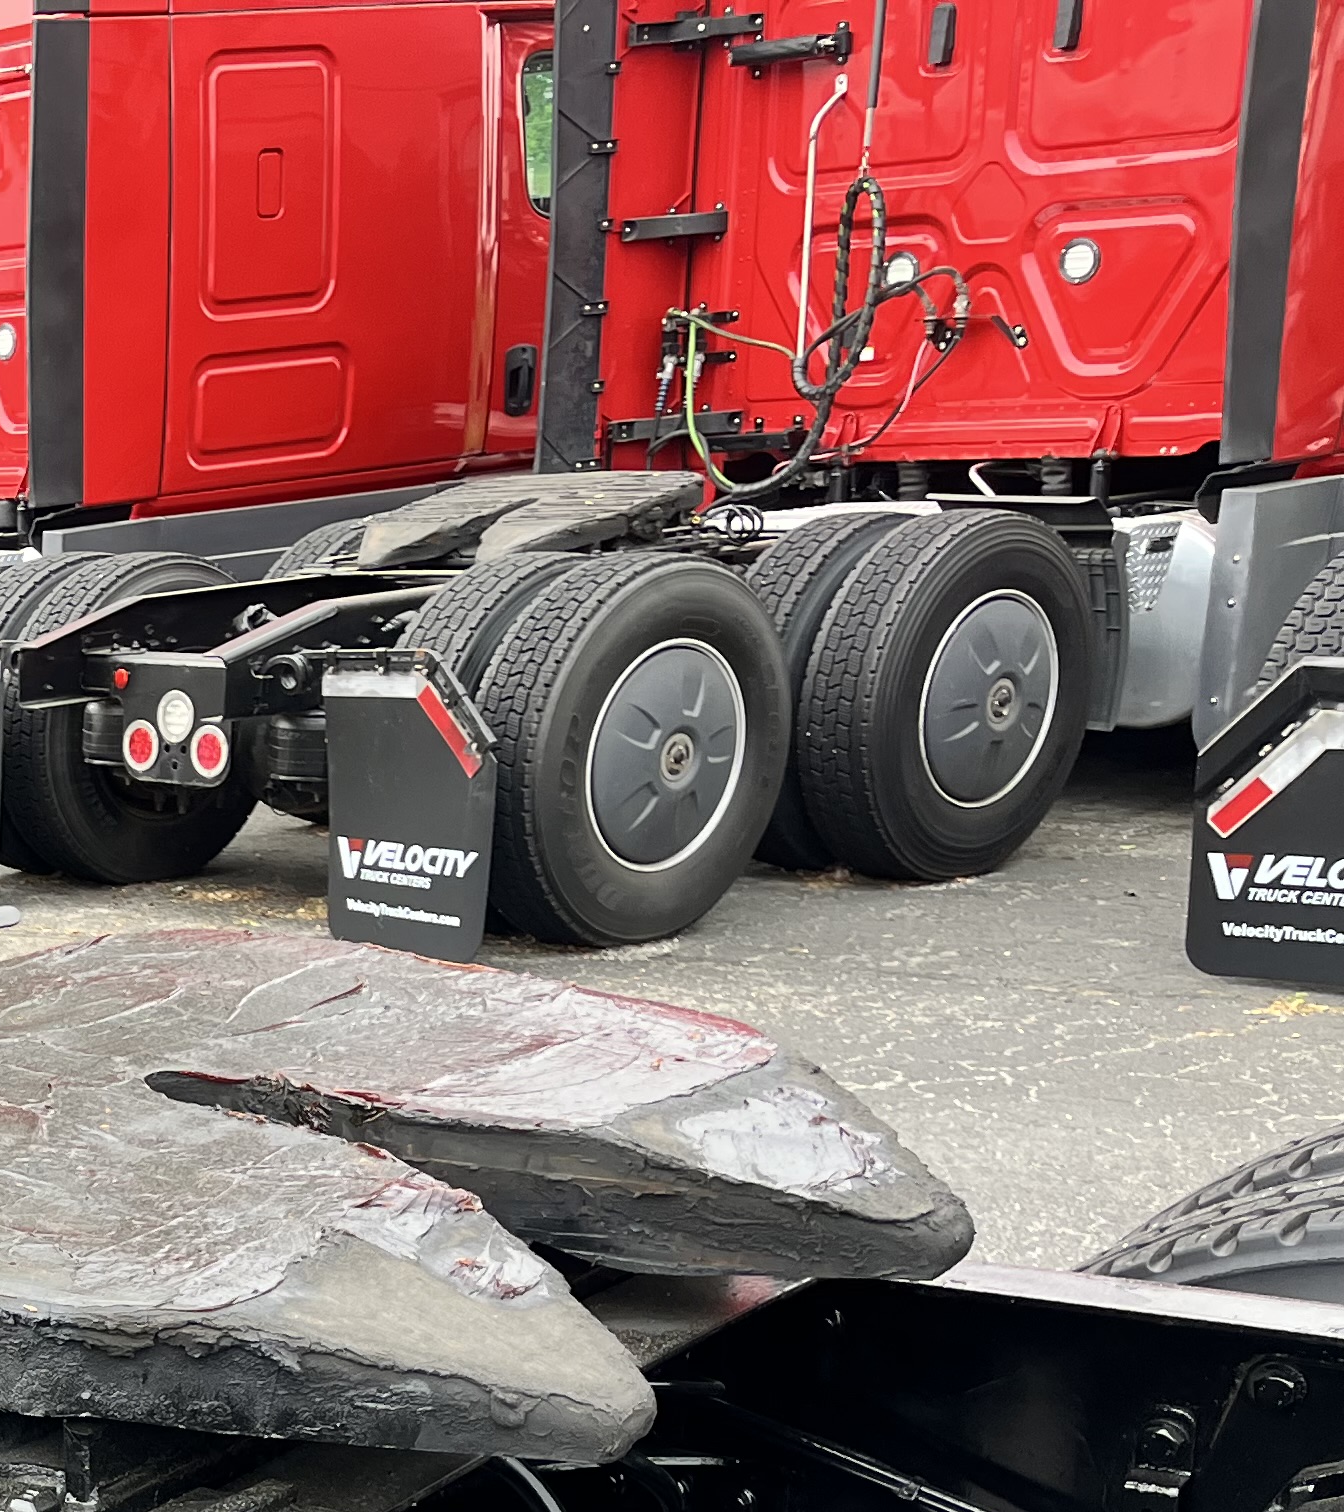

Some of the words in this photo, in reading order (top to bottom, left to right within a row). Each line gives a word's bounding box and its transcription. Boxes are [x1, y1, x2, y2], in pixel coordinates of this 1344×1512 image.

[362, 839, 479, 878] VELOCITY
[360, 868, 390, 884] TRUCK
[390, 873, 432, 890] CENTERS
[1247, 887, 1300, 904] TRUCK
